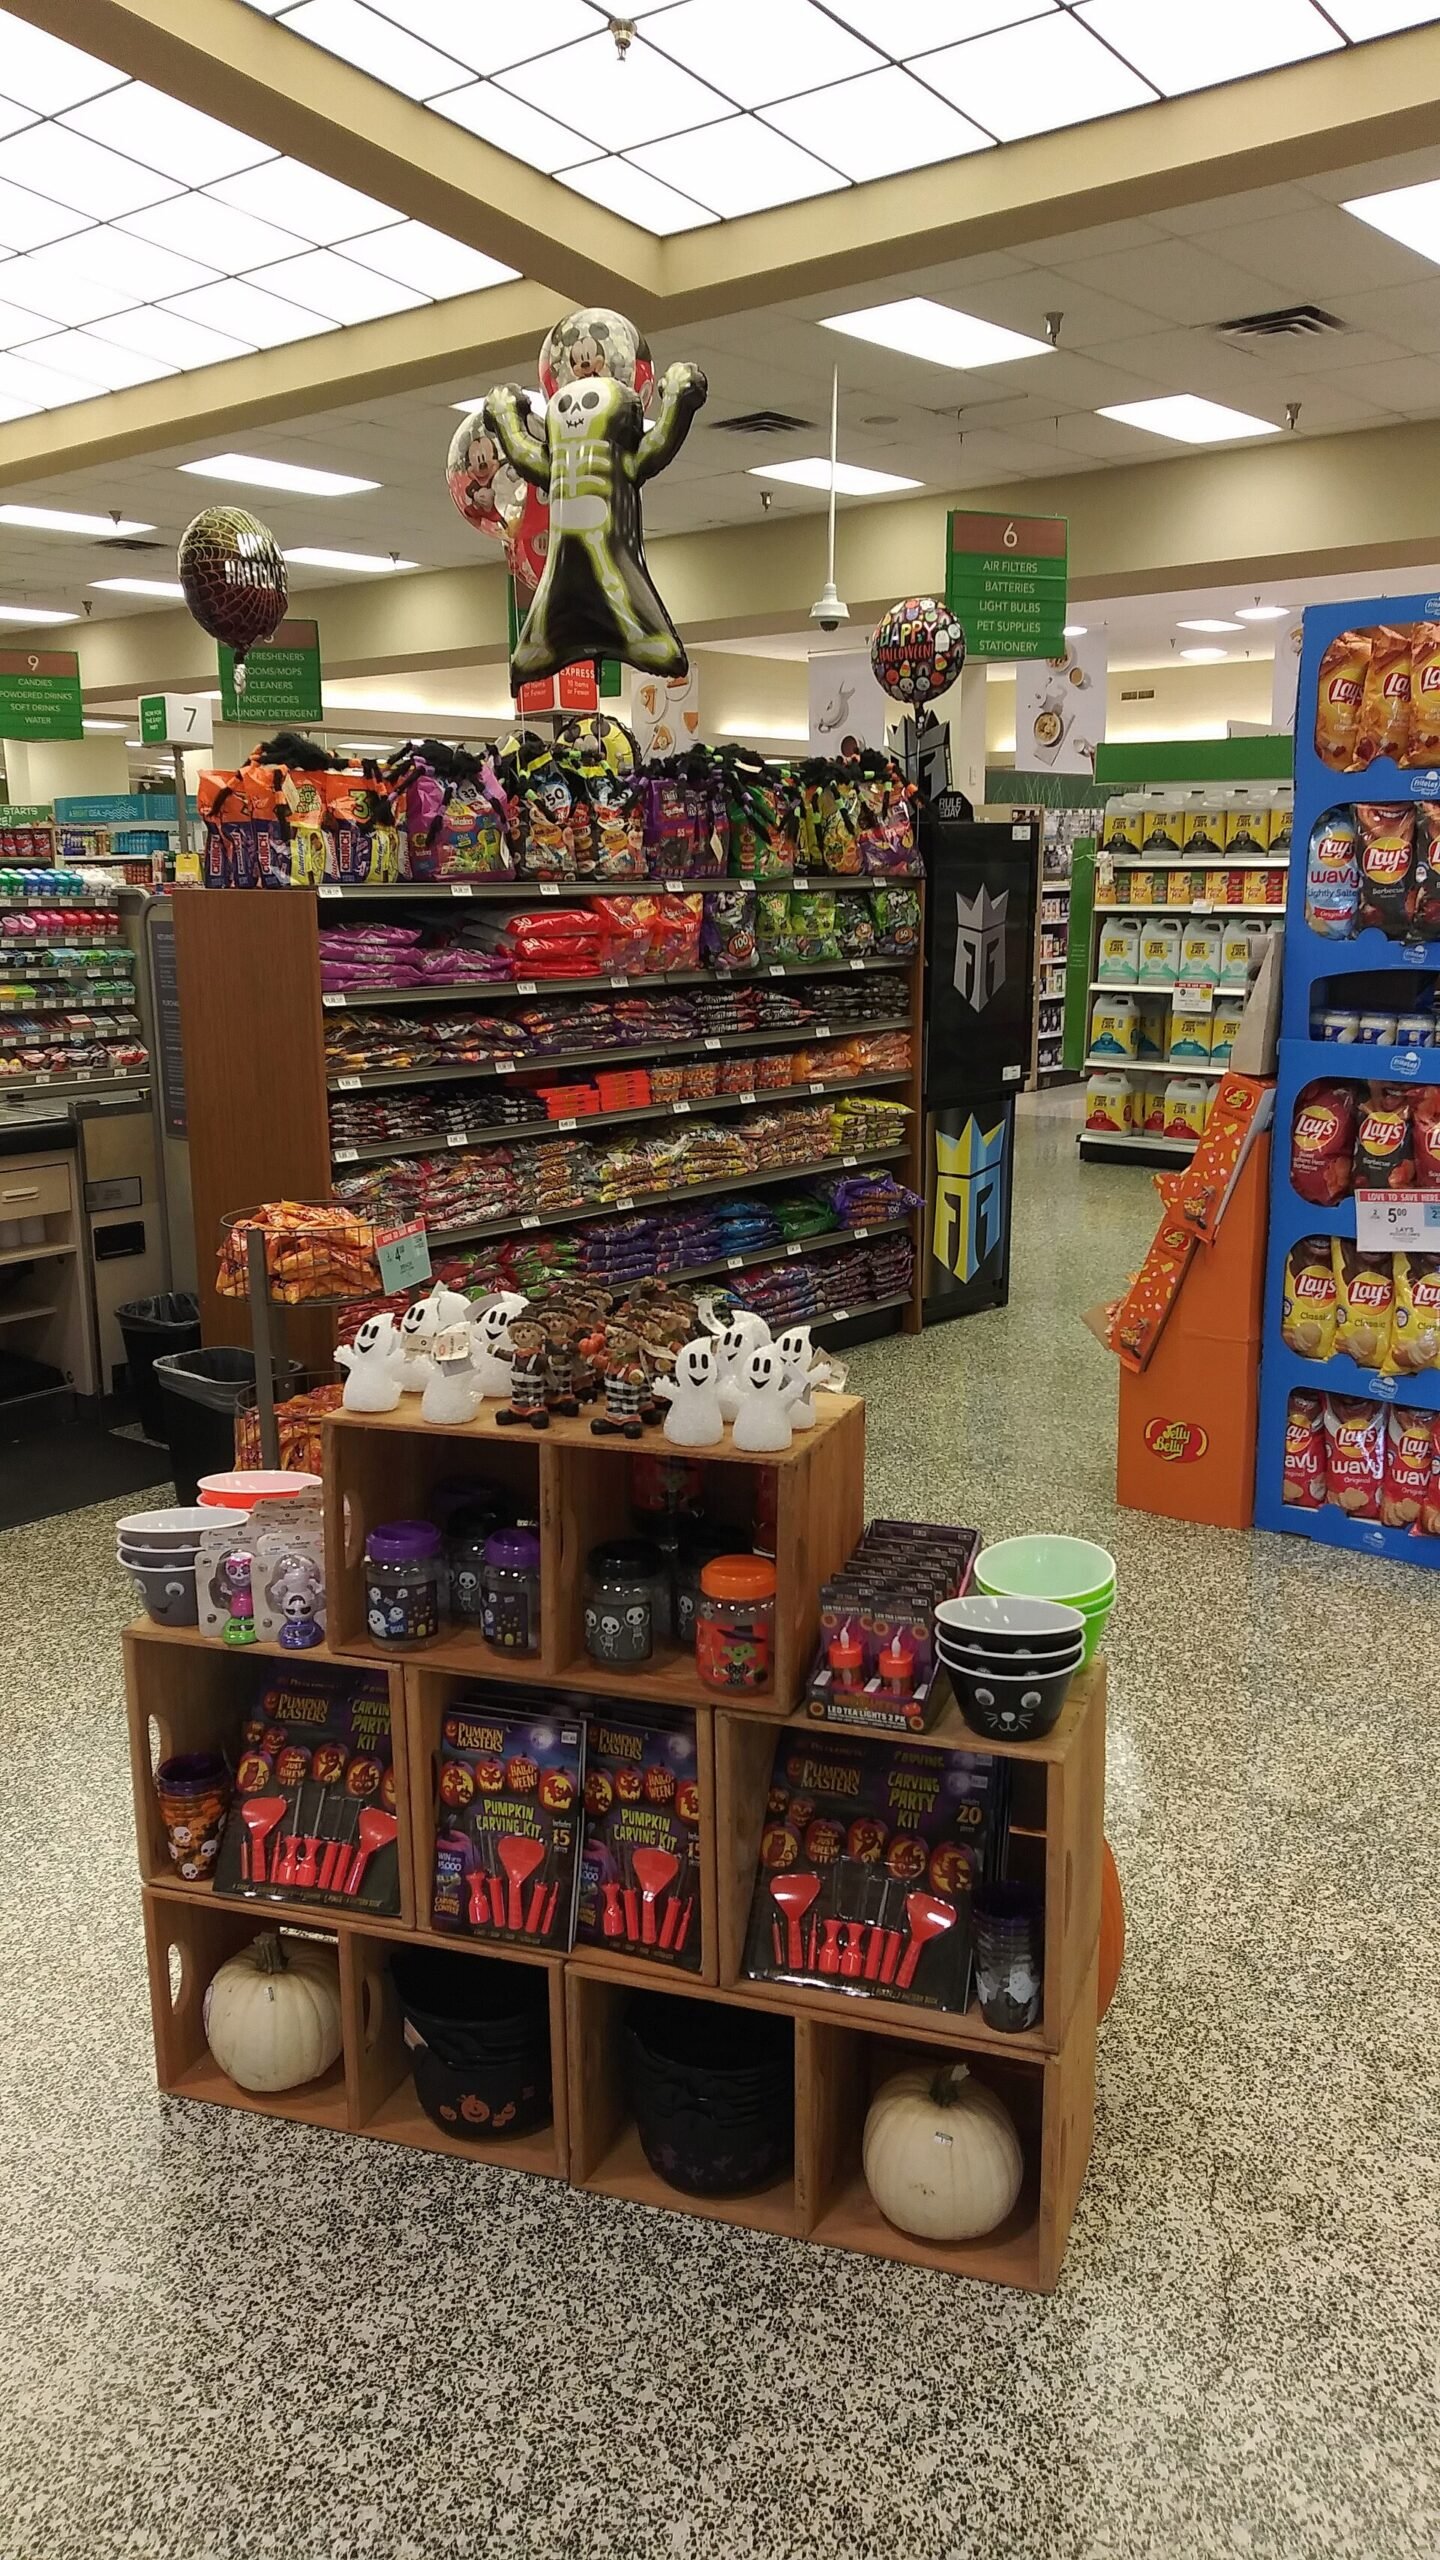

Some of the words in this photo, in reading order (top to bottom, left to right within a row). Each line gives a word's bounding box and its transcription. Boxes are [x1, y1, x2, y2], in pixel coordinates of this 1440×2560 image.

[1003, 522, 1018, 548] 6
[983, 560, 999, 571] AIR
[1002, 562, 1038, 574] FILTERS
[985, 581, 1035, 594] BATTERIES
[979, 601, 1007, 612] LIGHT
[1010, 602, 1041, 614] BULBS
[880, 620, 937, 647] HAPPY
[977, 621, 995, 631] PET
[997, 622, 1041, 633] SUPPLIES
[979, 640, 1039, 652] STATIONERY
[27, 655, 40, 671] 9
[251, 652, 305, 661] FRESHENERS
[560, 667, 595, 679] EXPRESS
[17, 678, 53, 687] CANDIES
[249, 681, 294, 690] CLEANERS
[567, 679, 574, 687] 10
[0, 690, 43, 700] POWDERED
[44, 692, 73, 701] DRINKS
[242, 695, 300, 704] INSECTICIDES
[10, 703, 30, 711] SOFT
[31, 704, 61, 712] DRINKS
[226, 708, 266, 717] LAUNDRY
[268, 708, 318, 718] DETERGENT
[24, 716, 52, 724] WATER
[183, 706, 197, 733] 7
[461, 788, 477, 799] 33
[546, 788, 565, 804] 50
[3, 807, 38, 816] STARTS
[939, 797, 962, 809] RULE
[944, 807, 961, 818] DAY
[259, 834, 270, 873] CRUNCH
[341, 831, 350, 871] CRUNCH
[1367, 846, 1410, 873] Lay's
[1311, 868, 1360, 888] wavy
[1307, 888, 1335, 899] Lightly
[1336, 888, 1357, 898] Salte
[1372, 887, 1405, 896] Barbecue
[514, 917, 532, 929] 50
[734, 936, 748, 949] 100
[1295, 1115, 1335, 1140] Lay's
[1361, 1119, 1402, 1145] Lay's
[1363, 1157, 1391, 1167] Barbecue
[1367, 1193, 1385, 1201] LOVE
[1388, 1193, 1397, 1201] TO
[1400, 1194, 1418, 1202] SAVE
[1297, 1275, 1336, 1300] Lay's
[1350, 1281, 1392, 1307] Lay's
[1413, 1284, 1440, 1309] Lay
[1354, 1320, 1386, 1328] Classic
[1163, 1421, 1190, 1444] Jelly
[1339, 1428, 1376, 1448] Lay's
[1152, 1436, 1184, 1460] Belly
[1402, 1437, 1429, 1460] Lay
[1285, 1452, 1317, 1473] avy
[1332, 1459, 1383, 1479] wavy
[1392, 1468, 1431, 1487] wav
[278, 1693, 329, 1713] PUMPKIN
[351, 1698, 391, 1716] CARVIN
[275, 1708, 328, 1724] MASTERS
[827, 1704, 842, 1714] LED
[843, 1707, 858, 1717] TEA
[860, 1709, 887, 1719] LIGHTS
[888, 1713, 894, 1721] 2
[895, 1714, 906, 1723] PK
[351, 1715, 391, 1735] PARTY
[458, 1722, 503, 1743] PUMPKIN
[357, 1734, 378, 1750] KIT
[457, 1736, 503, 1752] MASTERS
[600, 1728, 643, 1750] PUMPKIN
[598, 1743, 642, 1760] MASTERS
[803, 1759, 861, 1786] PUMPKIN
[801, 1777, 859, 1796] MASTERS
[888, 1771, 940, 1793] CARVING
[484, 1799, 534, 1820] PUMPKIN
[889, 1788, 935, 1813] PARTY
[621, 1808, 670, 1832] PUMPKIN
[897, 1810, 921, 1829] KIT
[956, 1805, 982, 1825] 20
[476, 1815, 520, 1834] CARVING
[523, 1822, 541, 1838] KIT
[552, 1829, 570, 1846] 15
[614, 1824, 656, 1845] CARVING
[659, 1834, 677, 1851] KIT
